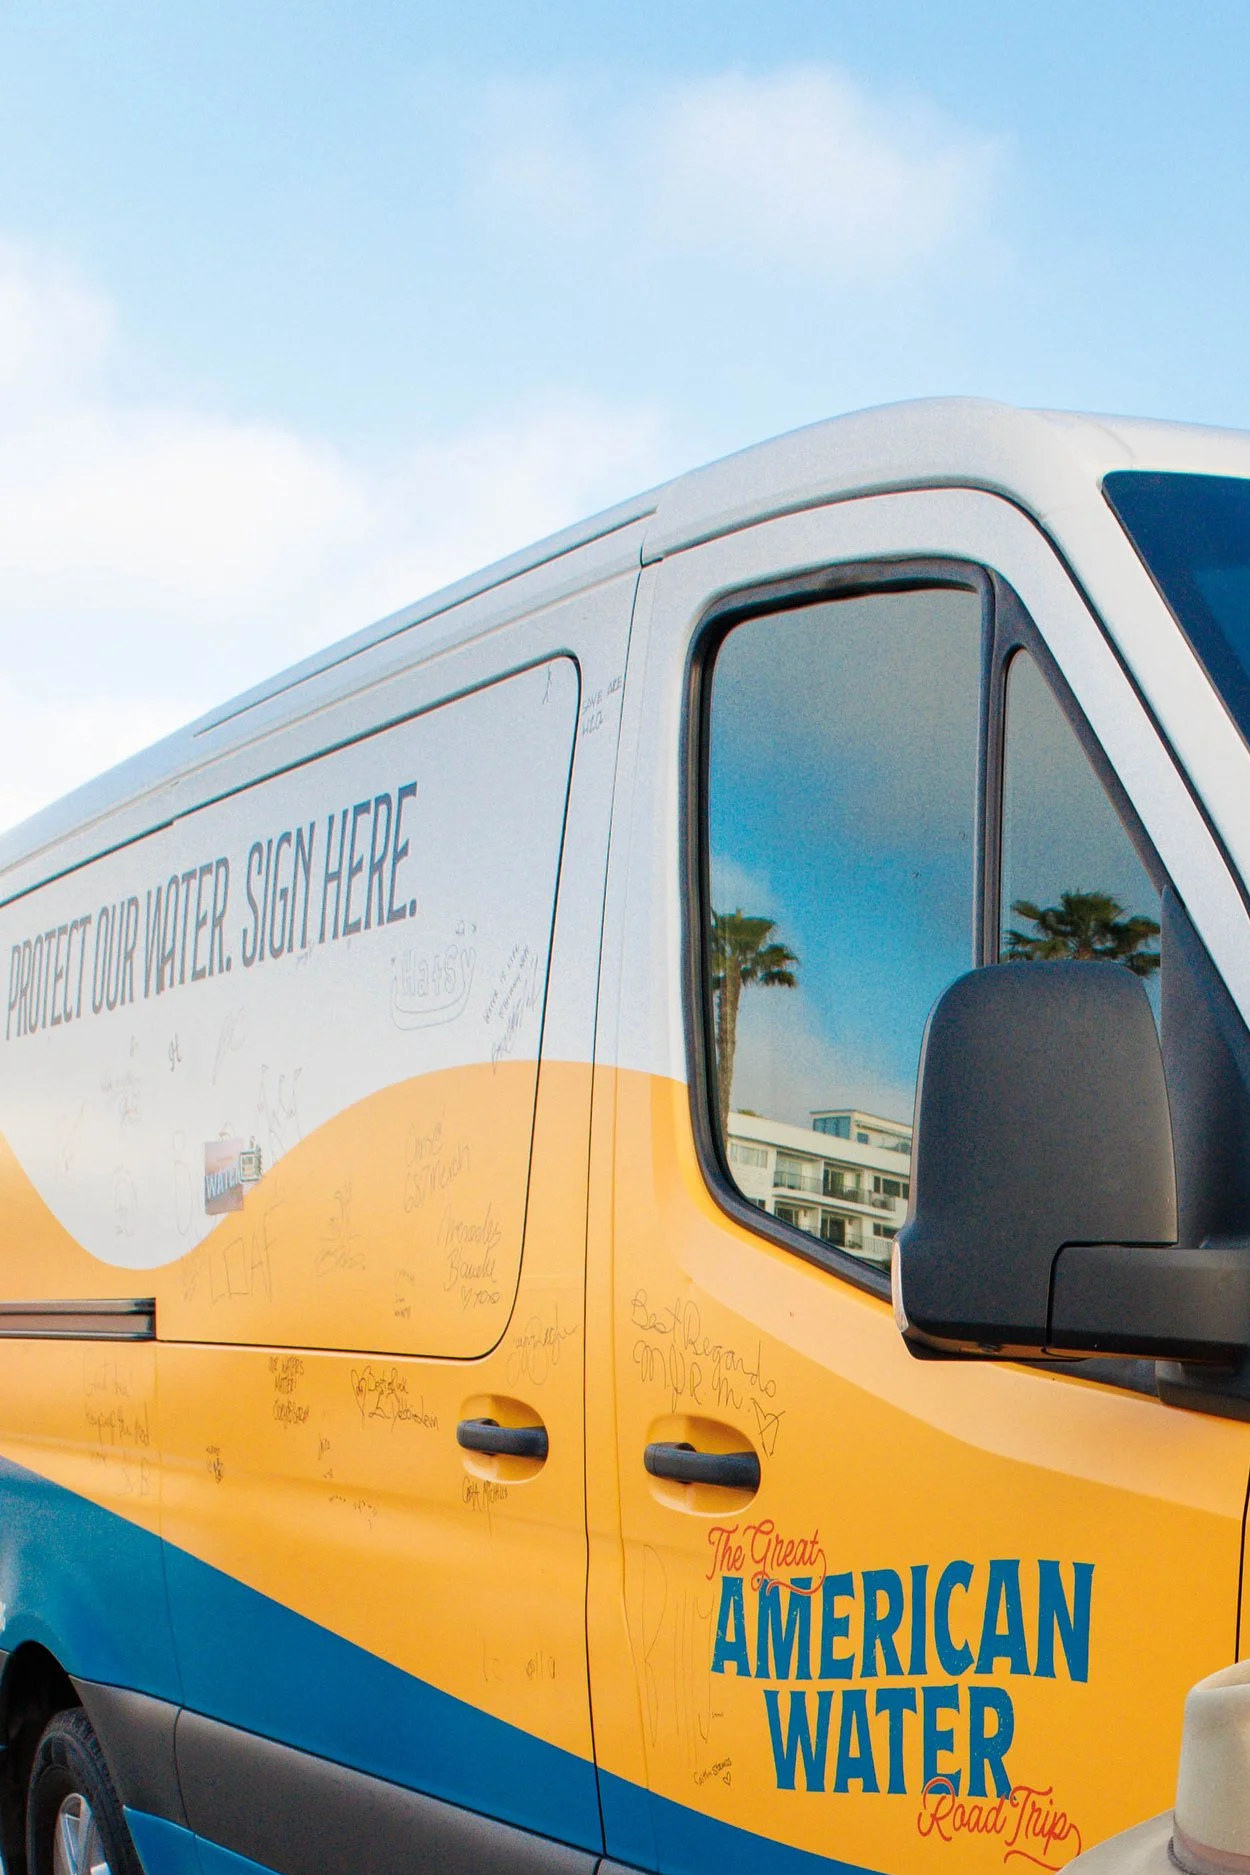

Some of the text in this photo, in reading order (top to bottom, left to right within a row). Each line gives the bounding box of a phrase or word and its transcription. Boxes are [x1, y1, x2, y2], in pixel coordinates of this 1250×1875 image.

[6, 780, 419, 1041] PROTECT OUR WATER. SIGN HERE.
[706, 1519, 827, 1595] The Great
[711, 1559, 1095, 1683] AMERICAN
[762, 1684, 1018, 1801] WATER
[917, 1776, 1083, 1871] Road Trip
